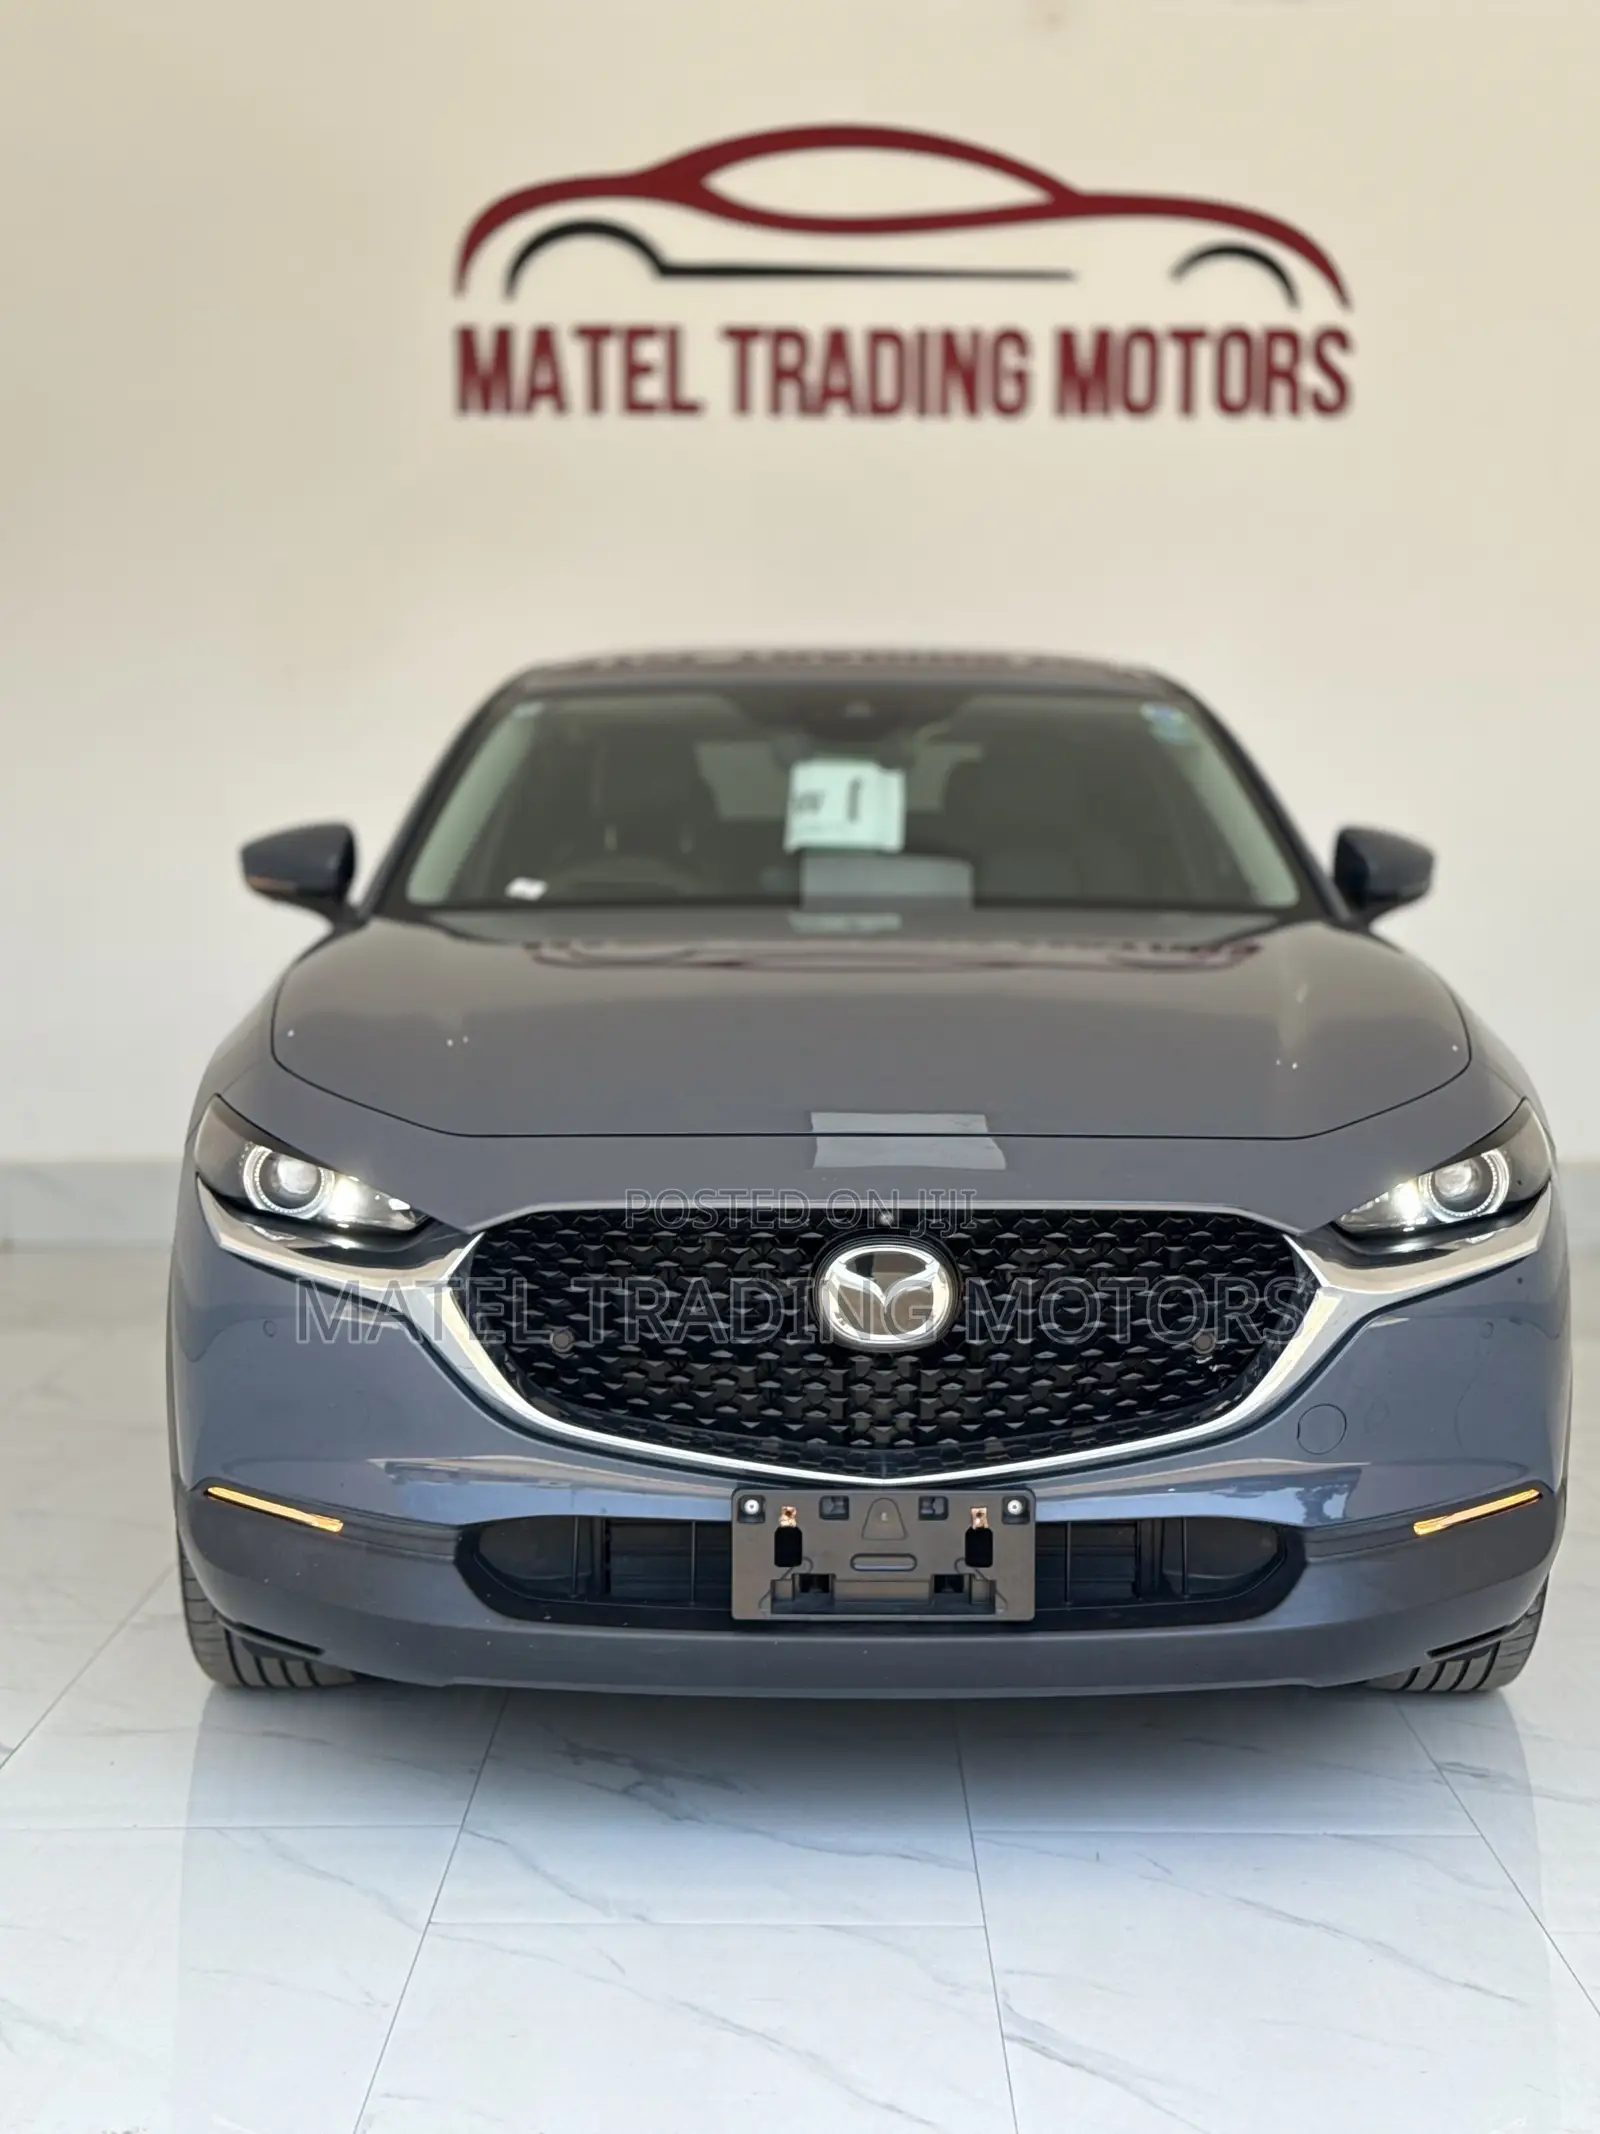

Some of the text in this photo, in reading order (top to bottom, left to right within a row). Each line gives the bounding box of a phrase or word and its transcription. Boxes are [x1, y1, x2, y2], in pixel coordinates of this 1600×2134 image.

[455, 324, 1354, 420] MATEL TRADING MOTORS
